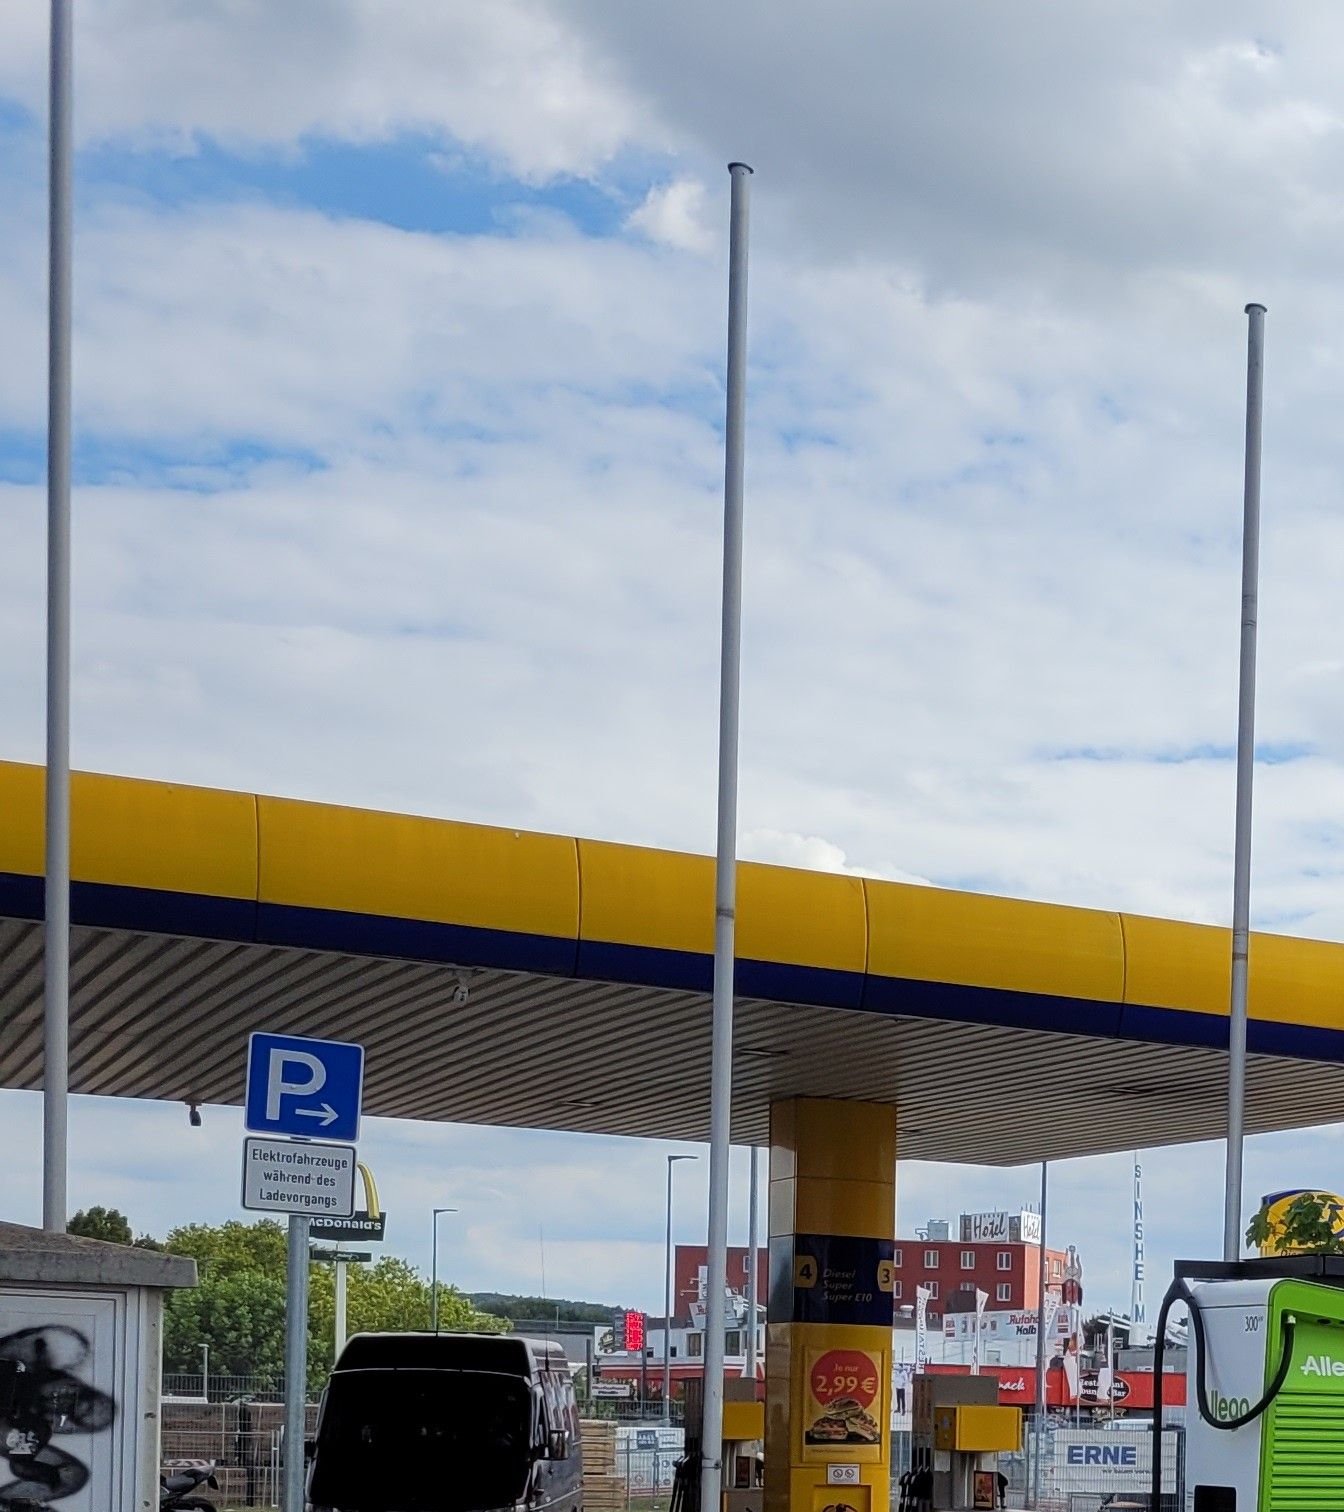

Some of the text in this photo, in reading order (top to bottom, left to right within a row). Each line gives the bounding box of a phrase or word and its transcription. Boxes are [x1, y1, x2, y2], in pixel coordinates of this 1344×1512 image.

[265, 1048, 327, 1120] P
[252, 1148, 348, 1170] Elektrofahrzeuge
[263, 1170, 336, 1187] während des
[259, 1188, 338, 1207] Ladevorgangs
[973, 1213, 1006, 1239] Hotel
[1134, 1164, 1145, 1323] SINSHEIM
[800, 1263, 812, 1280] 4
[823, 1269, 856, 1279] Diesel
[881, 1268, 890, 1283] 3
[823, 1280, 853, 1292] Super
[823, 1292, 872, 1303] Super E10
[1006, 1314, 1039, 1325] Autoho
[1245, 1316, 1258, 1331] 300
[1016, 1326, 1036, 1335] Kalb
[816, 1376, 875, 1396] 2,99 €
[999, 1377, 1025, 1391] nack
[1067, 1445, 1136, 1465] ERNE
